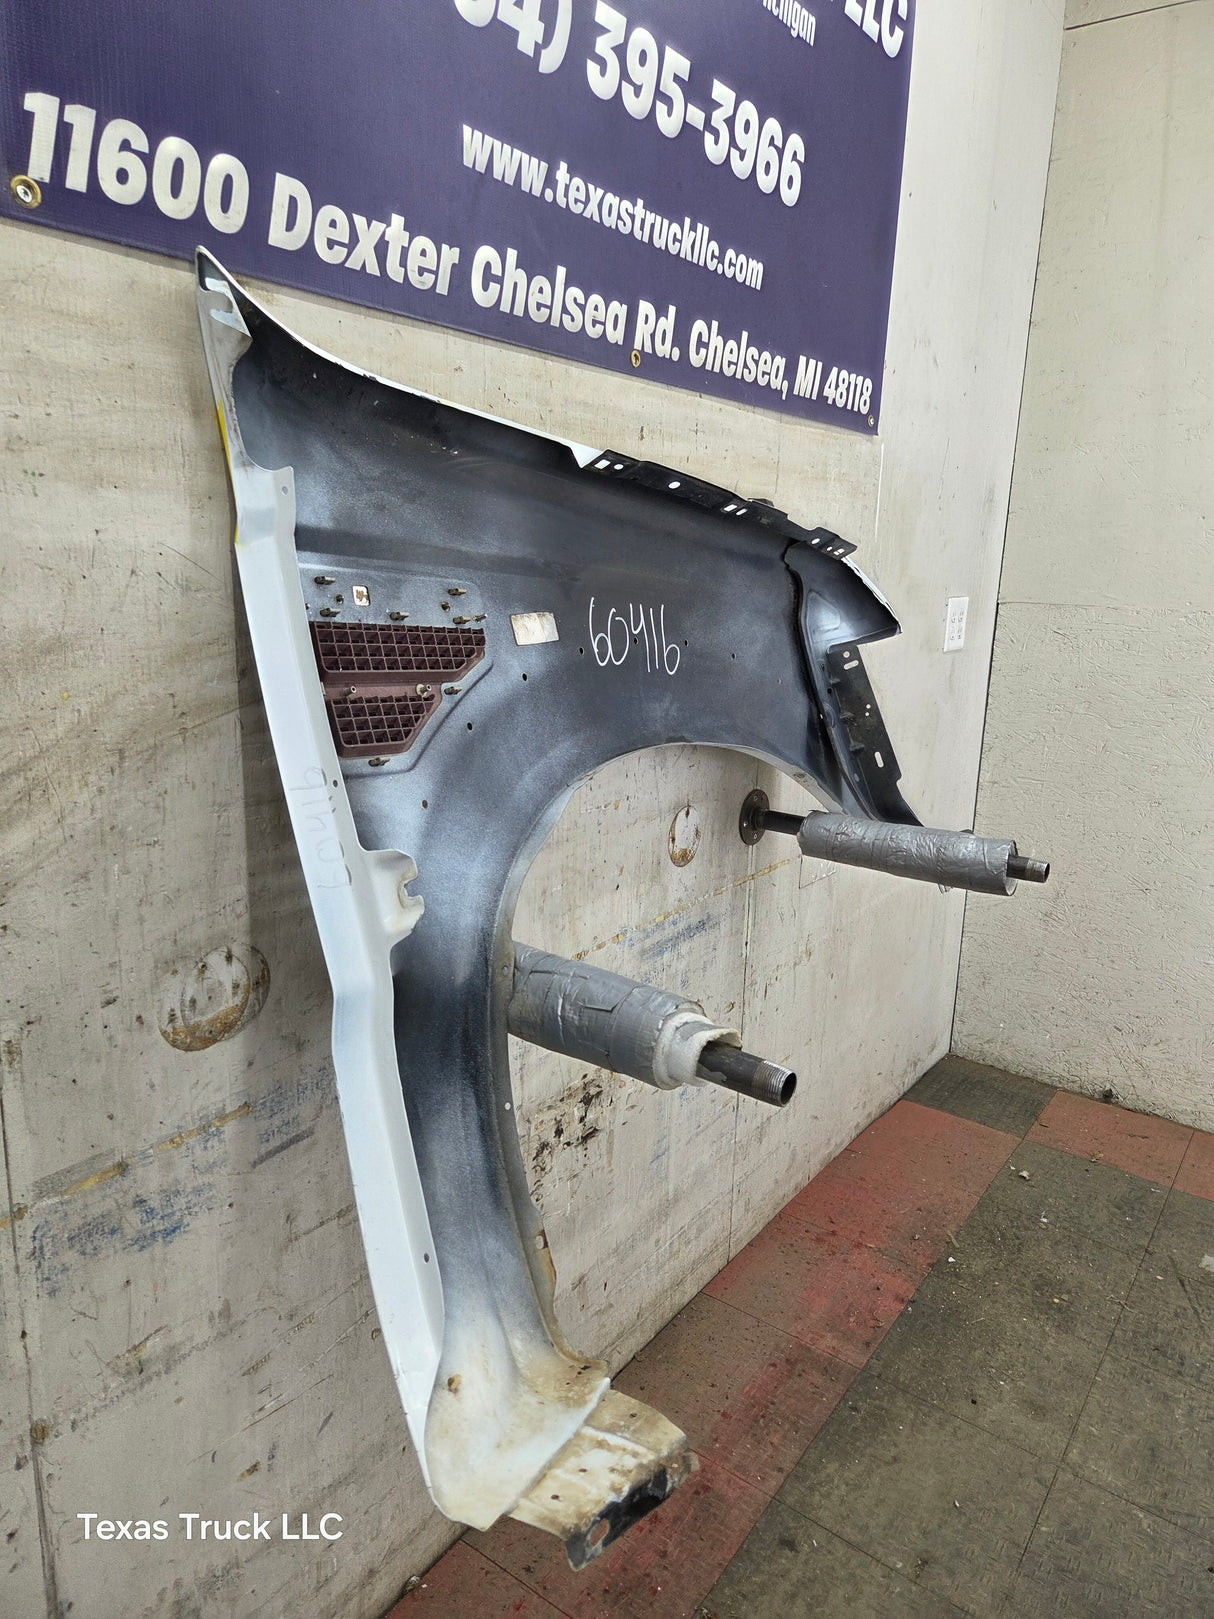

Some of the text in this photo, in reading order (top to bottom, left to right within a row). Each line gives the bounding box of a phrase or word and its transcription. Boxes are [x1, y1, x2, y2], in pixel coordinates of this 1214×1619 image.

[454, 0, 805, 207] 4) 395-3966
[24, 92, 873, 415] 11600 Dexter Chelsea Rd. Chelsea, MI 48118
[462, 124, 764, 291] www.texastruckllc.com
[588, 597, 681, 675] 60416
